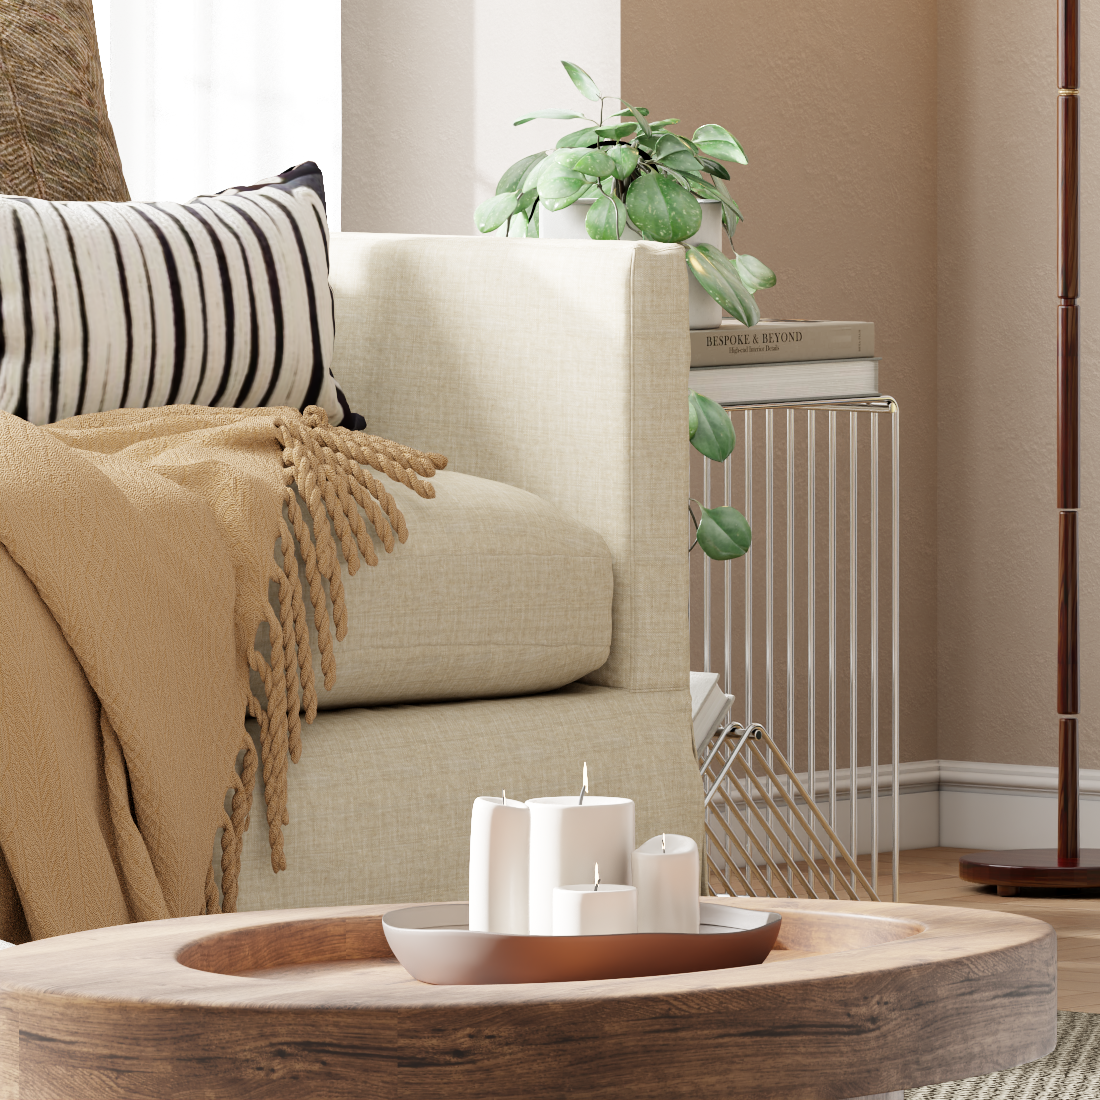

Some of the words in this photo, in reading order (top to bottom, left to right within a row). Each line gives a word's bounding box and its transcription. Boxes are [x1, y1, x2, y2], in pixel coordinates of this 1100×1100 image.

[706, 334, 751, 347] BESPOKE
[752, 333, 760, 344] &
[762, 331, 804, 344] BEYOND
